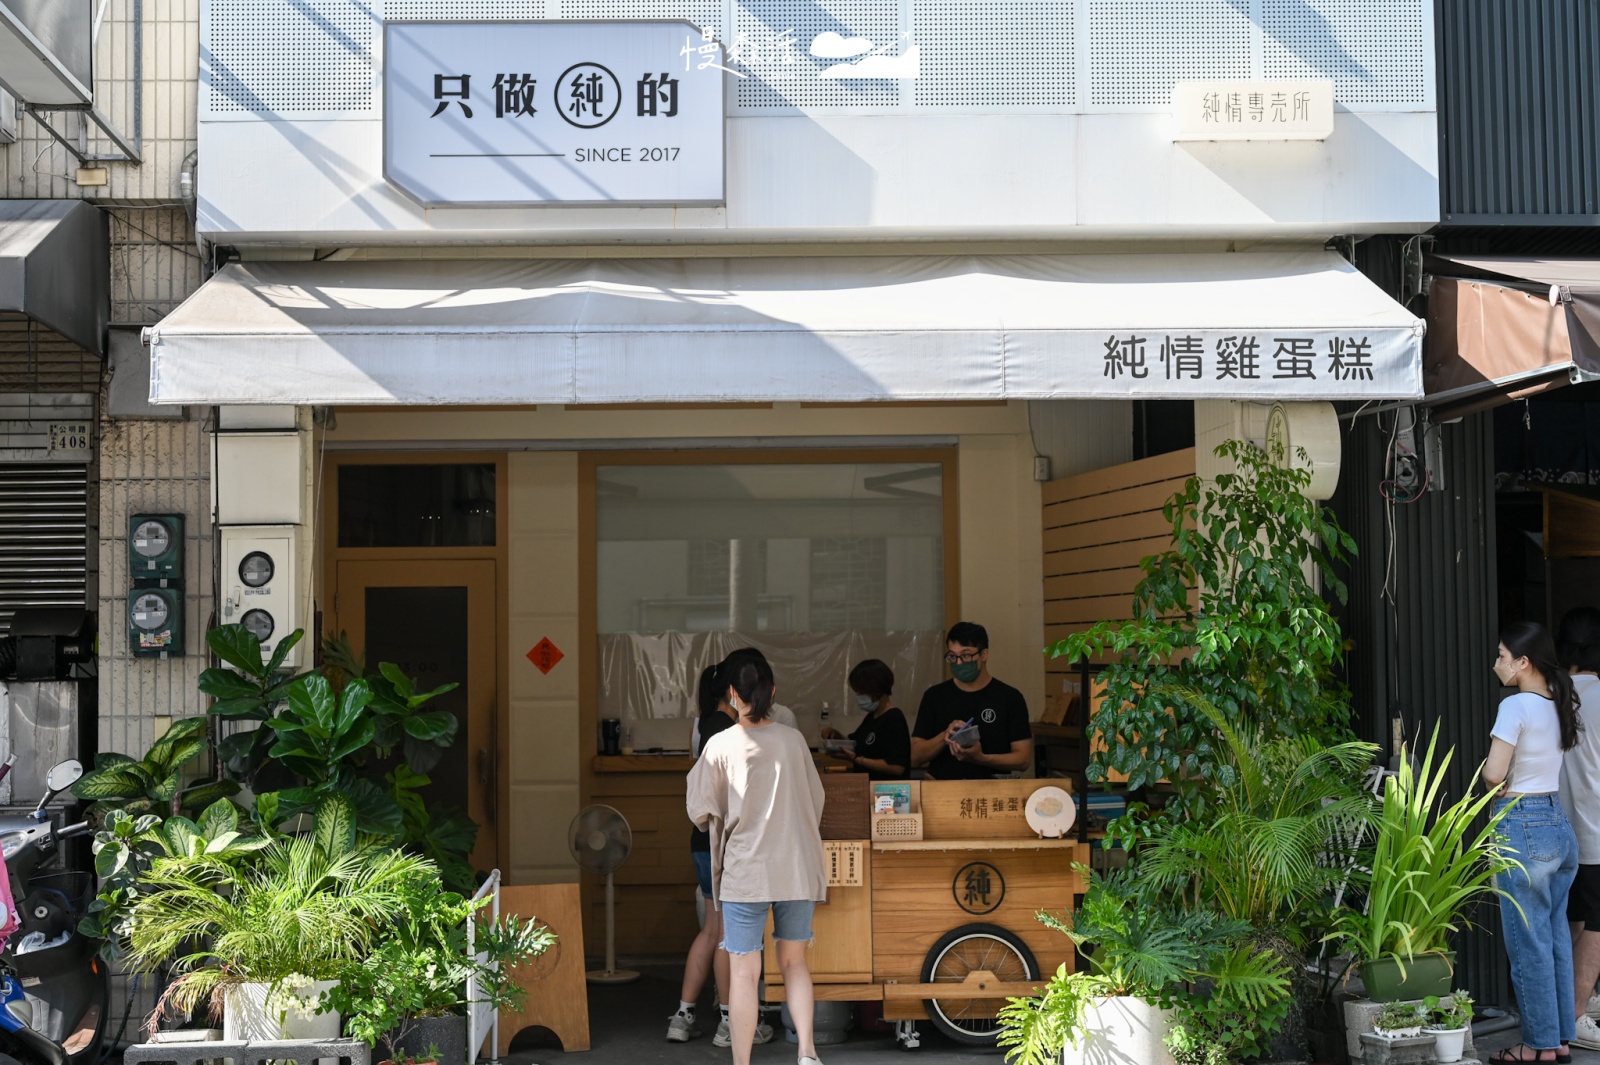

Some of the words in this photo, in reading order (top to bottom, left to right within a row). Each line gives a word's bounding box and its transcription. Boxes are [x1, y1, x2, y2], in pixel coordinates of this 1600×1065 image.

[429, 70, 680, 120] 只做純的
[574, 147, 632, 162] SINCE
[639, 147, 681, 162] 2017
[1103, 334, 1374, 381] 純情雞蛋糕
[59, 435, 86, 449] 408
[963, 869, 991, 906] 純
